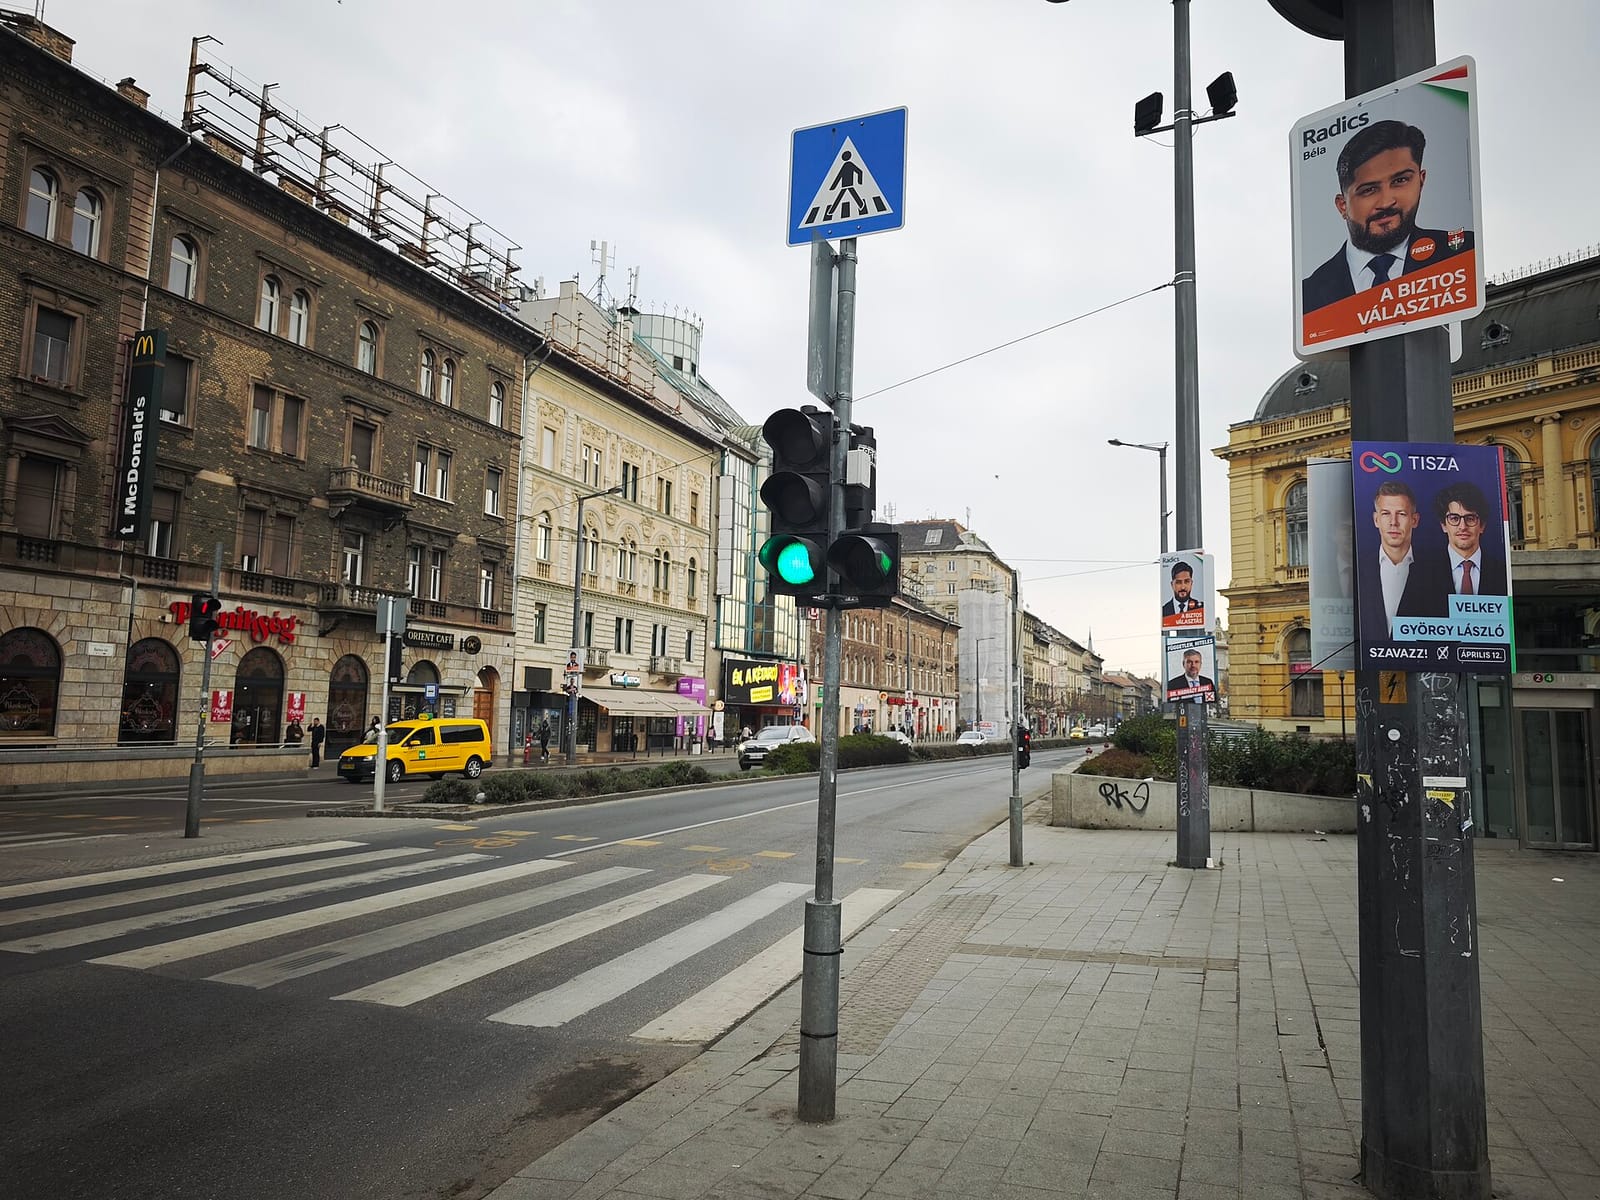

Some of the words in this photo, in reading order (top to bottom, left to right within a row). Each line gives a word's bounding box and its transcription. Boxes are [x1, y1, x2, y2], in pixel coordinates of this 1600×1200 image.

[1302, 112, 1369, 147] Radics
[1303, 147, 1326, 160] Béla
[1411, 243, 1434, 255] FIDESZ
[1380, 287, 1394, 302] A
[1398, 268, 1467, 298] BIZTOS
[1357, 287, 1467, 325] VÁLASZTÁS
[124, 395, 146, 515] McDonald's
[1408, 455, 1460, 471] TISZA
[1456, 602, 1502, 613] VELKEY
[408, 631, 435, 642] ORIENT
[1400, 622, 1454, 636] GYÖRGY
[1457, 623, 1505, 637] LÁSZLÓ
[1369, 648, 1428, 659] SZAVAZZ!
[1461, 651, 1491, 659] ÁPRILIS
